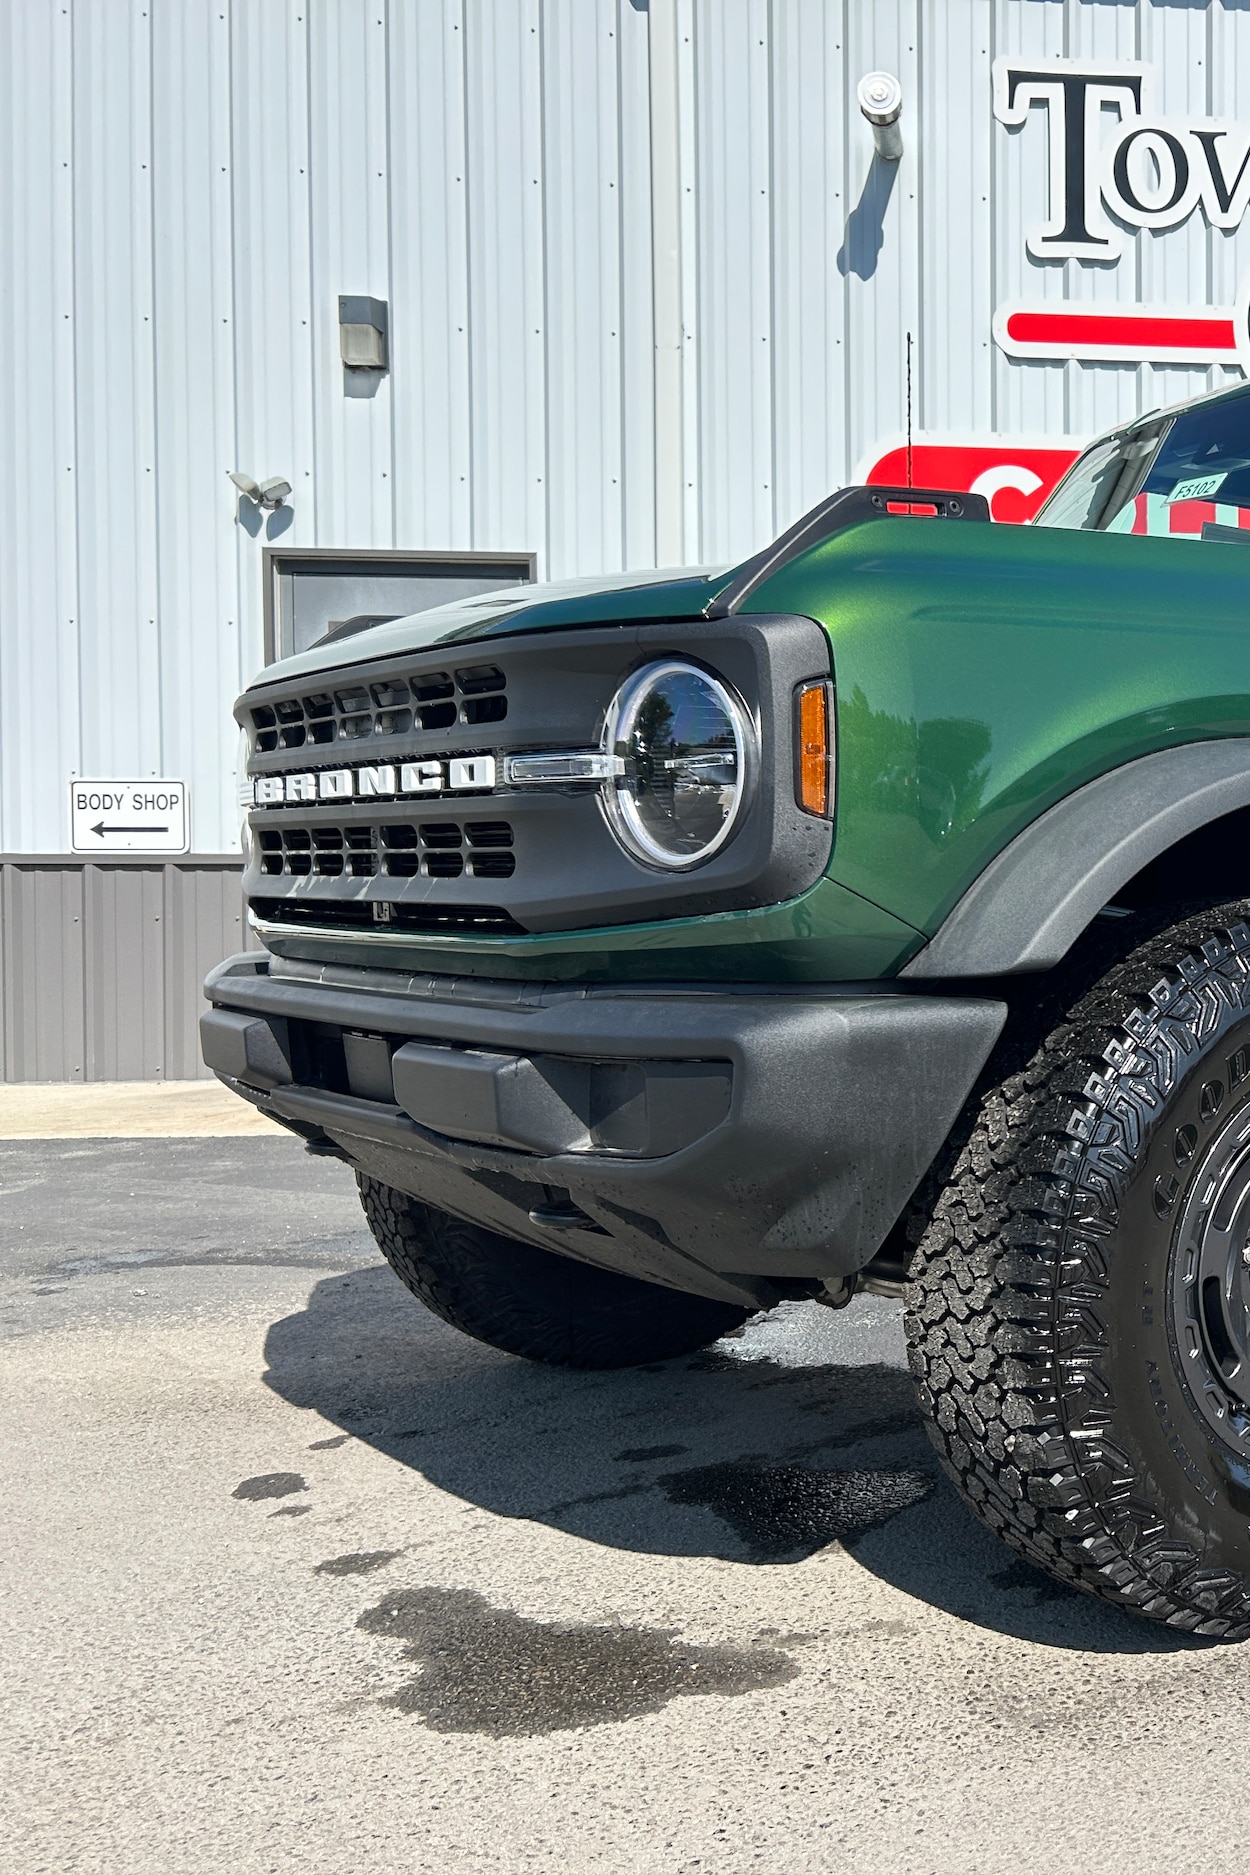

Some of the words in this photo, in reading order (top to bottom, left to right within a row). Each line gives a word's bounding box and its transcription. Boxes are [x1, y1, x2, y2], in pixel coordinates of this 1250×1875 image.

[1174, 480, 1216, 500] F5102
[256, 754, 496, 804] BRONCO
[77, 793, 124, 810] BODY
[132, 793, 179, 810] SHOP
